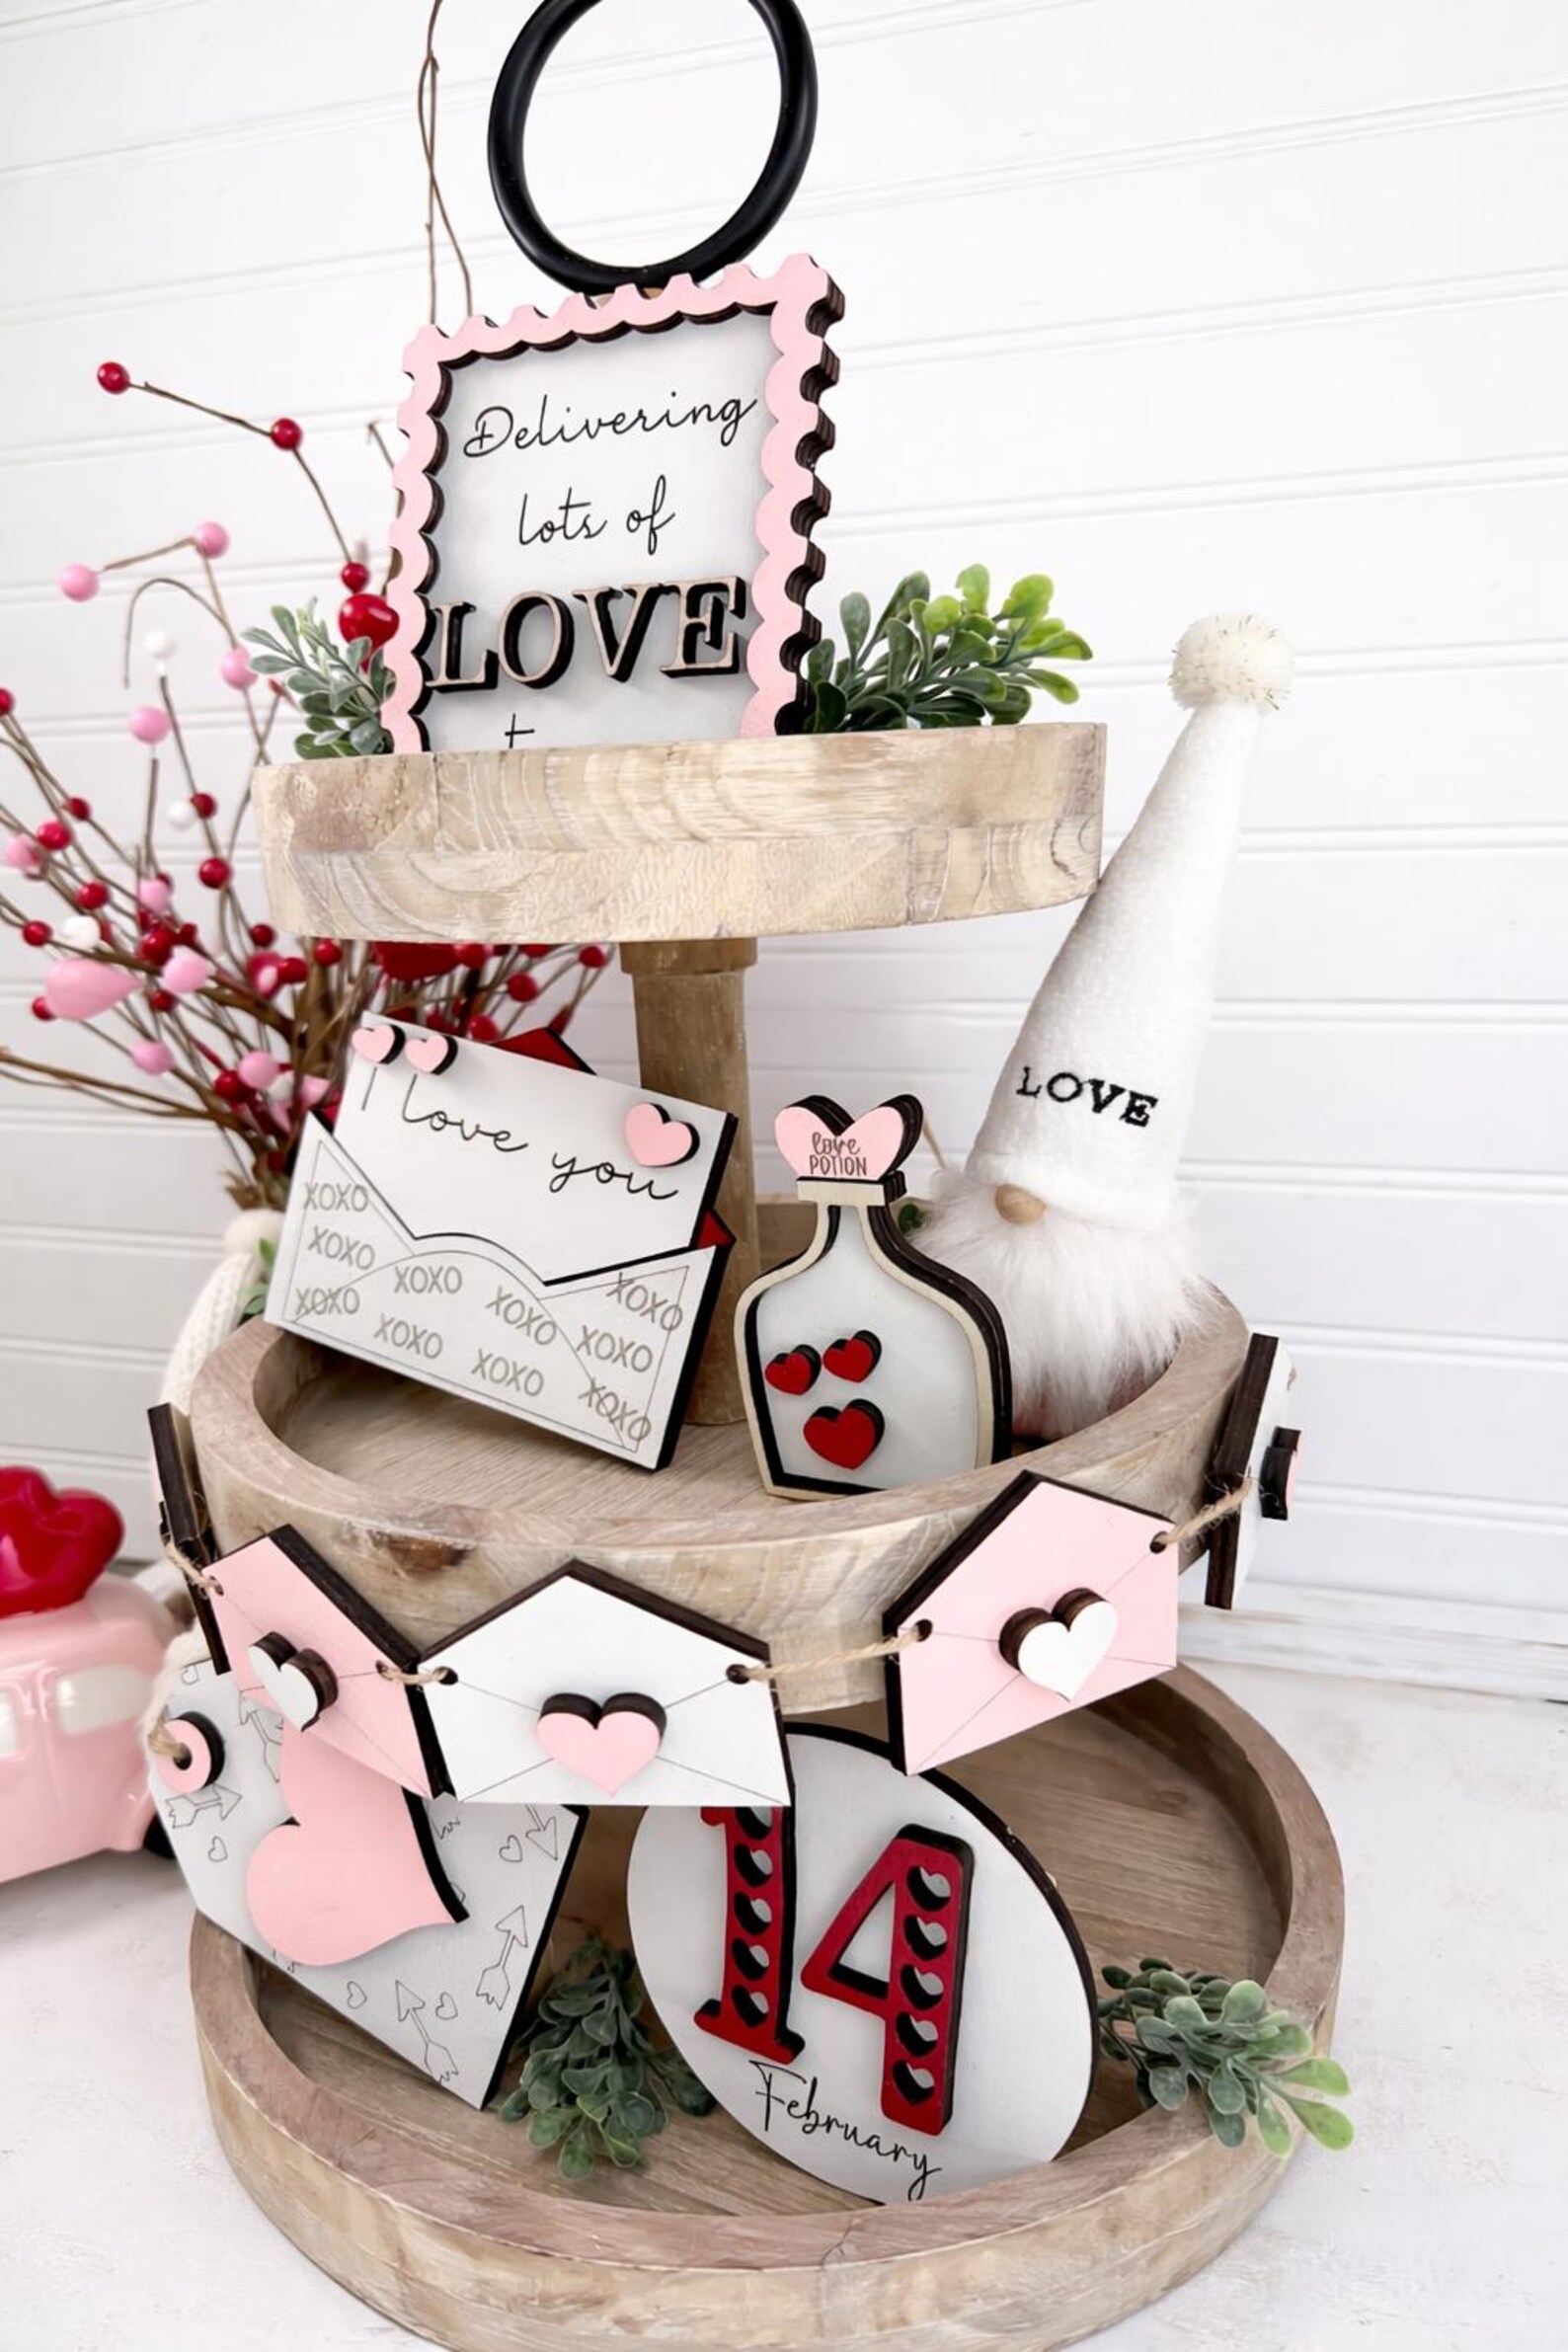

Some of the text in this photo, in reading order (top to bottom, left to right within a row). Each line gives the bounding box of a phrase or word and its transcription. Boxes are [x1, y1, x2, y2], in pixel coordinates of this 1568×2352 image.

[462, 391, 759, 459] Delivering
[517, 474, 676, 557] lots of
[426, 575, 747, 695] LOVE
[1015, 1065, 1159, 1129] LOVE
[360, 1066, 680, 1201] I love you
[811, 1131, 861, 1159] love
[808, 1154, 868, 1178] POTION
[303, 1181, 368, 1214] XOXO
[307, 1224, 376, 1271] XOXO
[295, 1287, 360, 1316] XOXO
[394, 1265, 464, 1295] XOXO
[606, 1272, 684, 1333] XOXO
[373, 1312, 443, 1360] XOXO
[486, 1286, 558, 1347] XOXO
[470, 1348, 545, 1397] XOXO
[576, 1324, 654, 1374] XOXO
[578, 1376, 653, 1443] XOXO
[692, 1805, 976, 2137] 14
[747, 2059, 943, 2203] February
